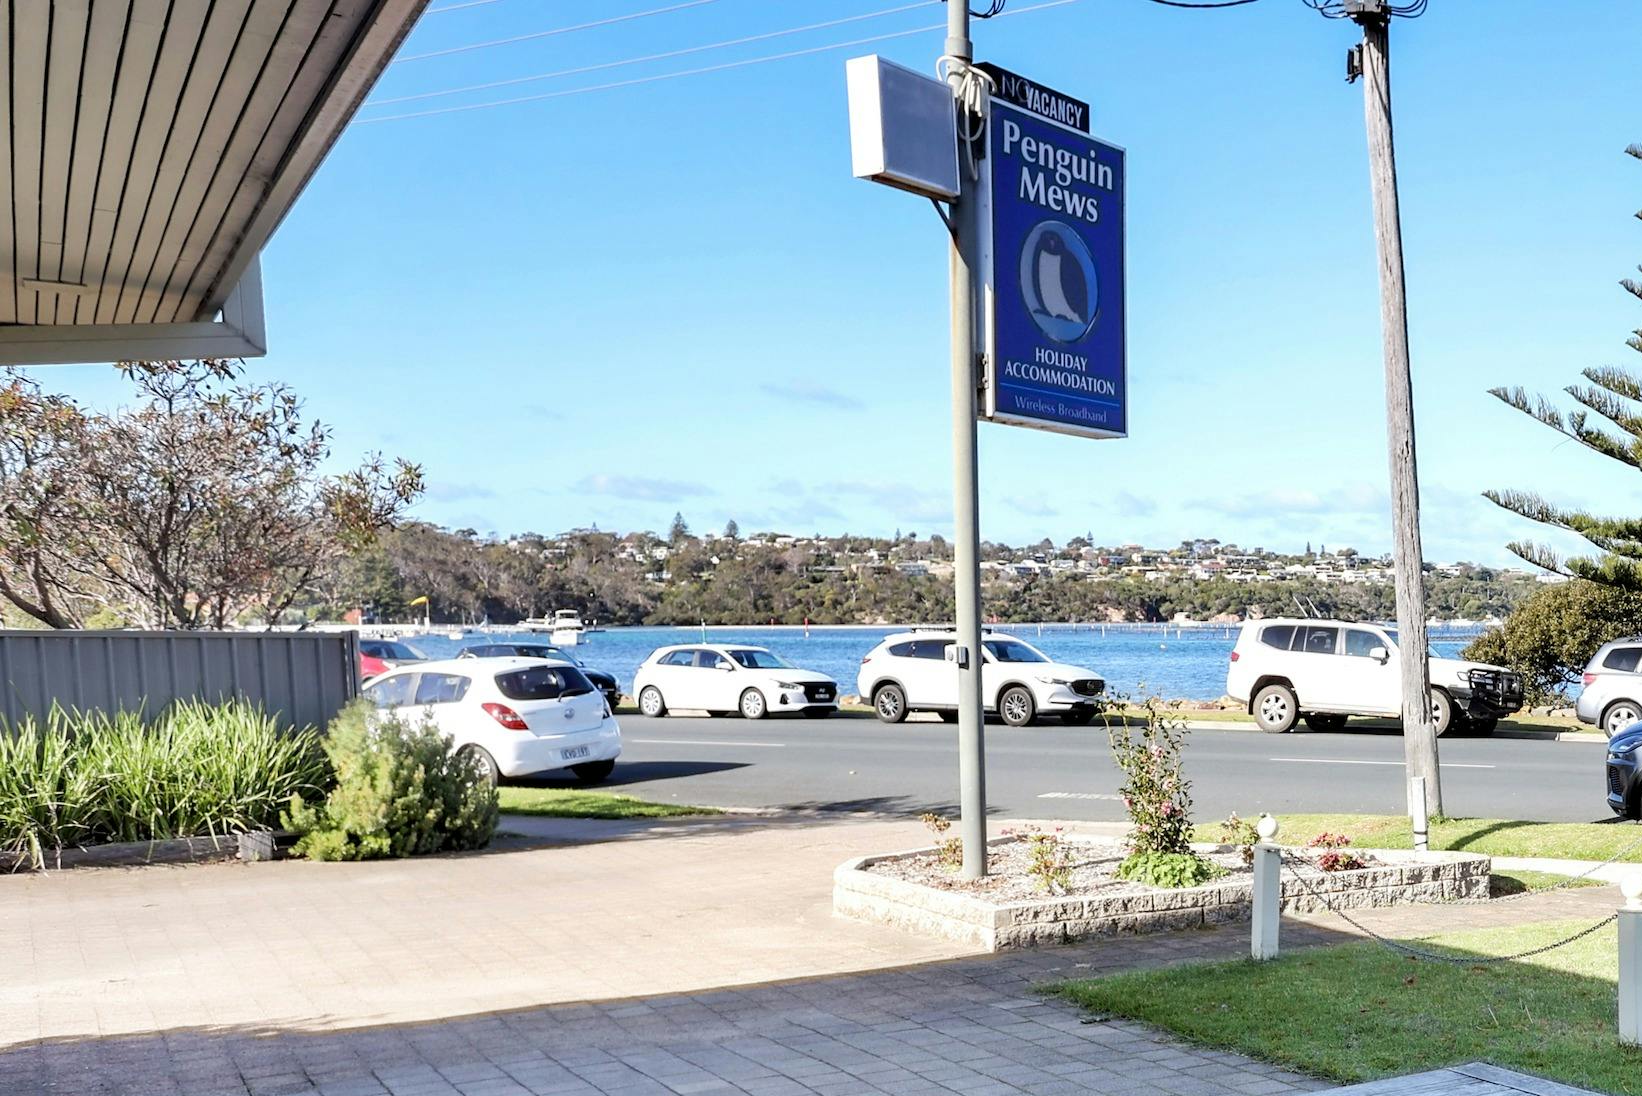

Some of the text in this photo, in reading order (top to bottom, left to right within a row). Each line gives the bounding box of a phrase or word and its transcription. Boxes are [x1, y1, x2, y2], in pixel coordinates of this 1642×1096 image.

[1002, 74, 1083, 128] NO VACANCY
[1003, 119, 1113, 190] Penguin
[1020, 166, 1098, 222] Mews
[1004, 360, 1115, 395] ACCOMMODATION
[1035, 347, 1088, 372] HOLIDAY
[1015, 394, 1107, 423] Wireless Broadband
